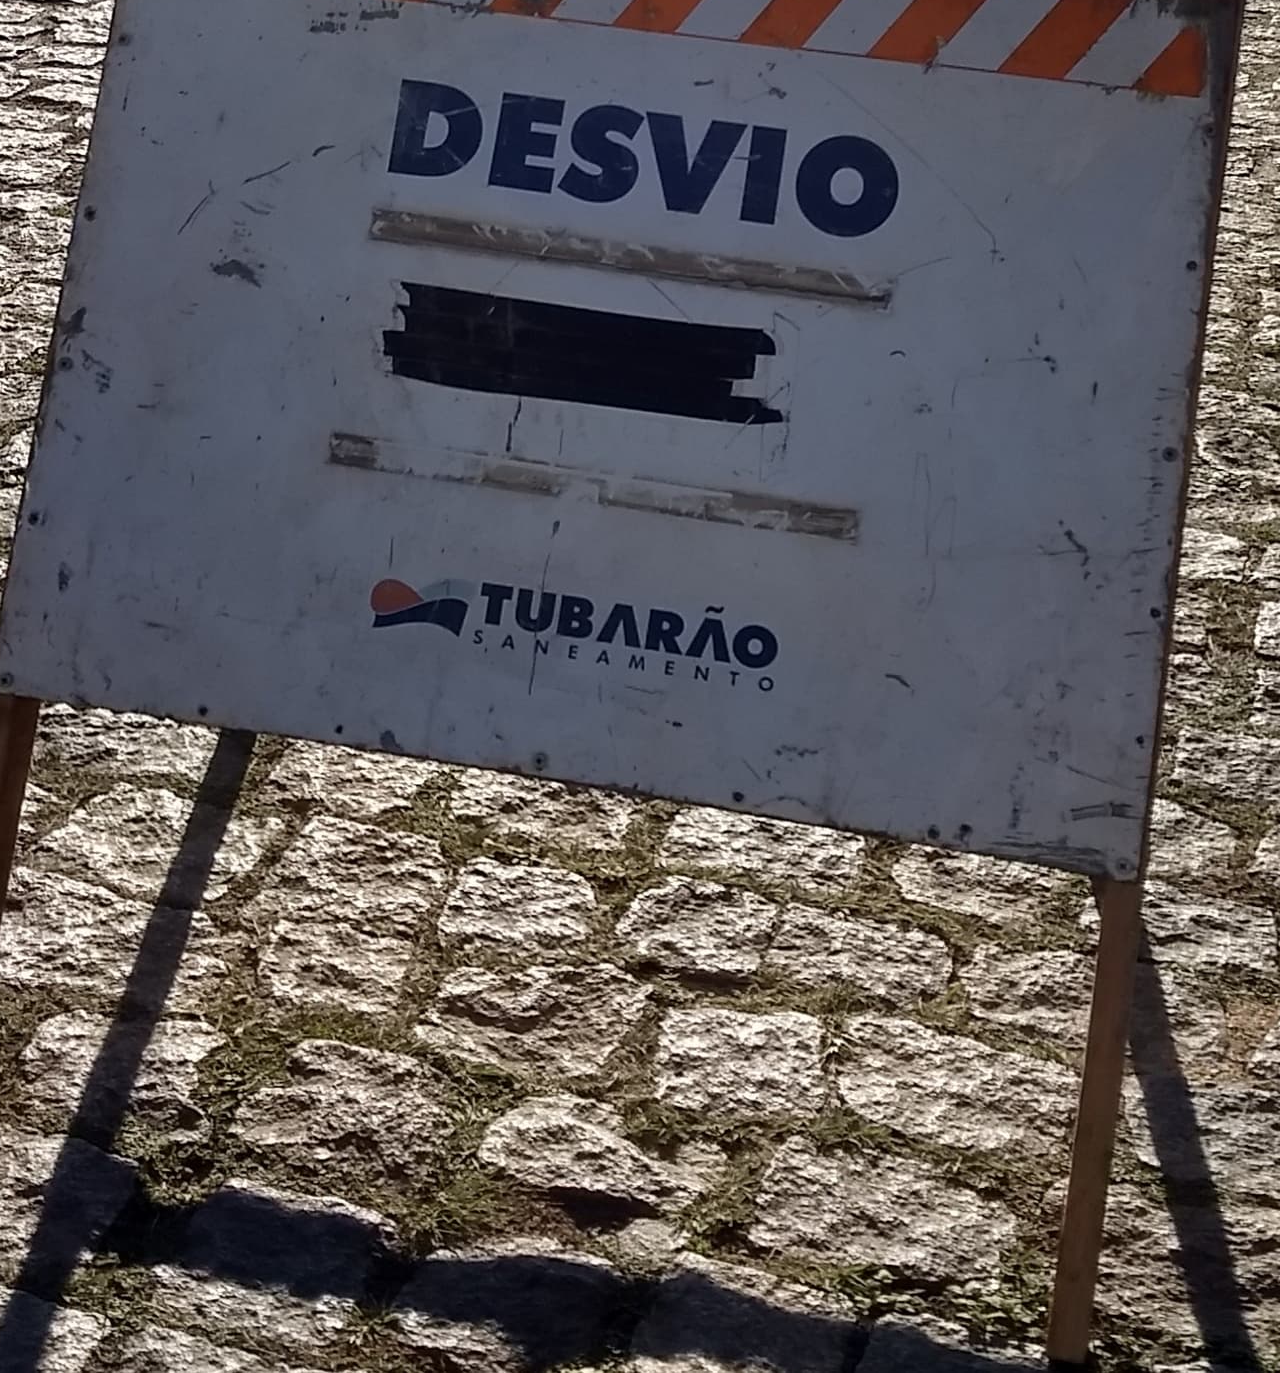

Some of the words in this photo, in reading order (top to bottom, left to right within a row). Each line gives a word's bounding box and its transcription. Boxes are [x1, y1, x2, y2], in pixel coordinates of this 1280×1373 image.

[387, 78, 899, 237] DESVIO
[473, 628, 774, 692] SANEAMENTO
[480, 582, 778, 669] TUBARÃO
